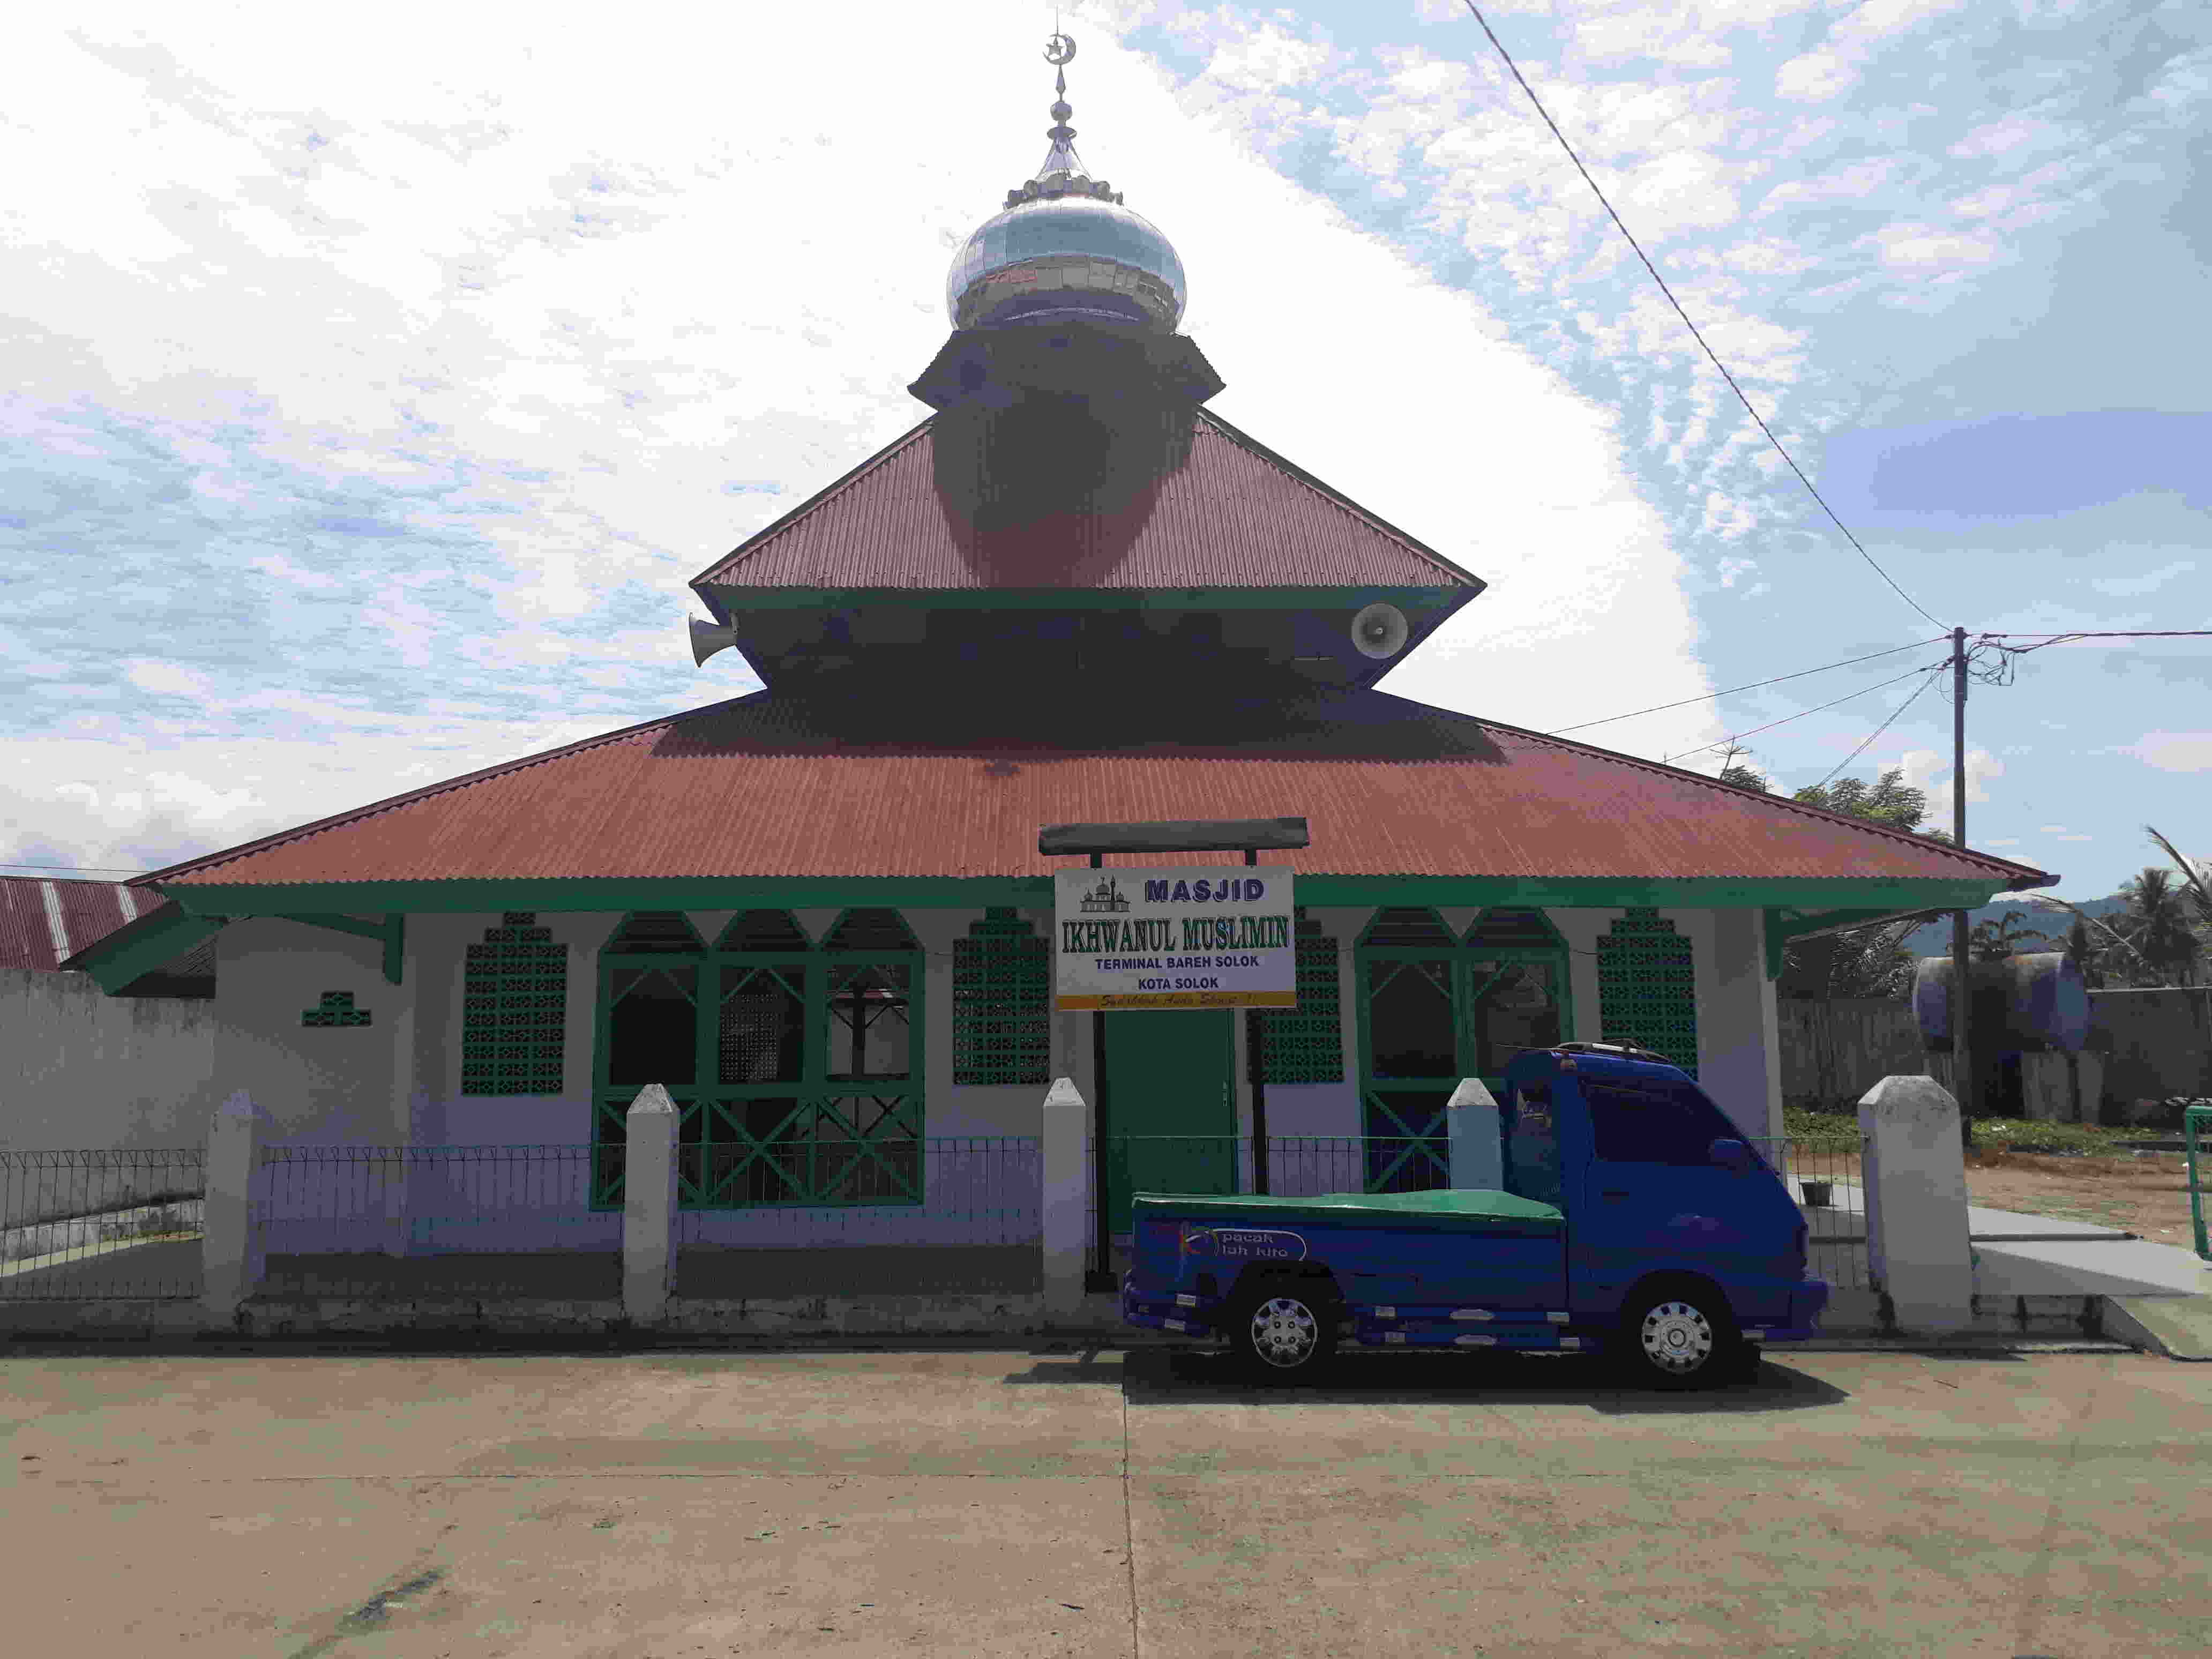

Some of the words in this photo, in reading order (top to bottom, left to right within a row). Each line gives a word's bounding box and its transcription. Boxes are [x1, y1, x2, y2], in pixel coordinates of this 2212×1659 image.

[1145, 878, 1265, 903] MASJID
[1062, 917, 1178, 953] IKHWANUL
[1182, 915, 1291, 951] MUSLIMIN
[1095, 958, 1162, 970] TERMINAL
[1167, 956, 1211, 969] BAREH
[1215, 955, 1260, 968] SOLOK
[1138, 978, 1171, 990] KOTA
[1175, 977, 1219, 990] SOLOK
